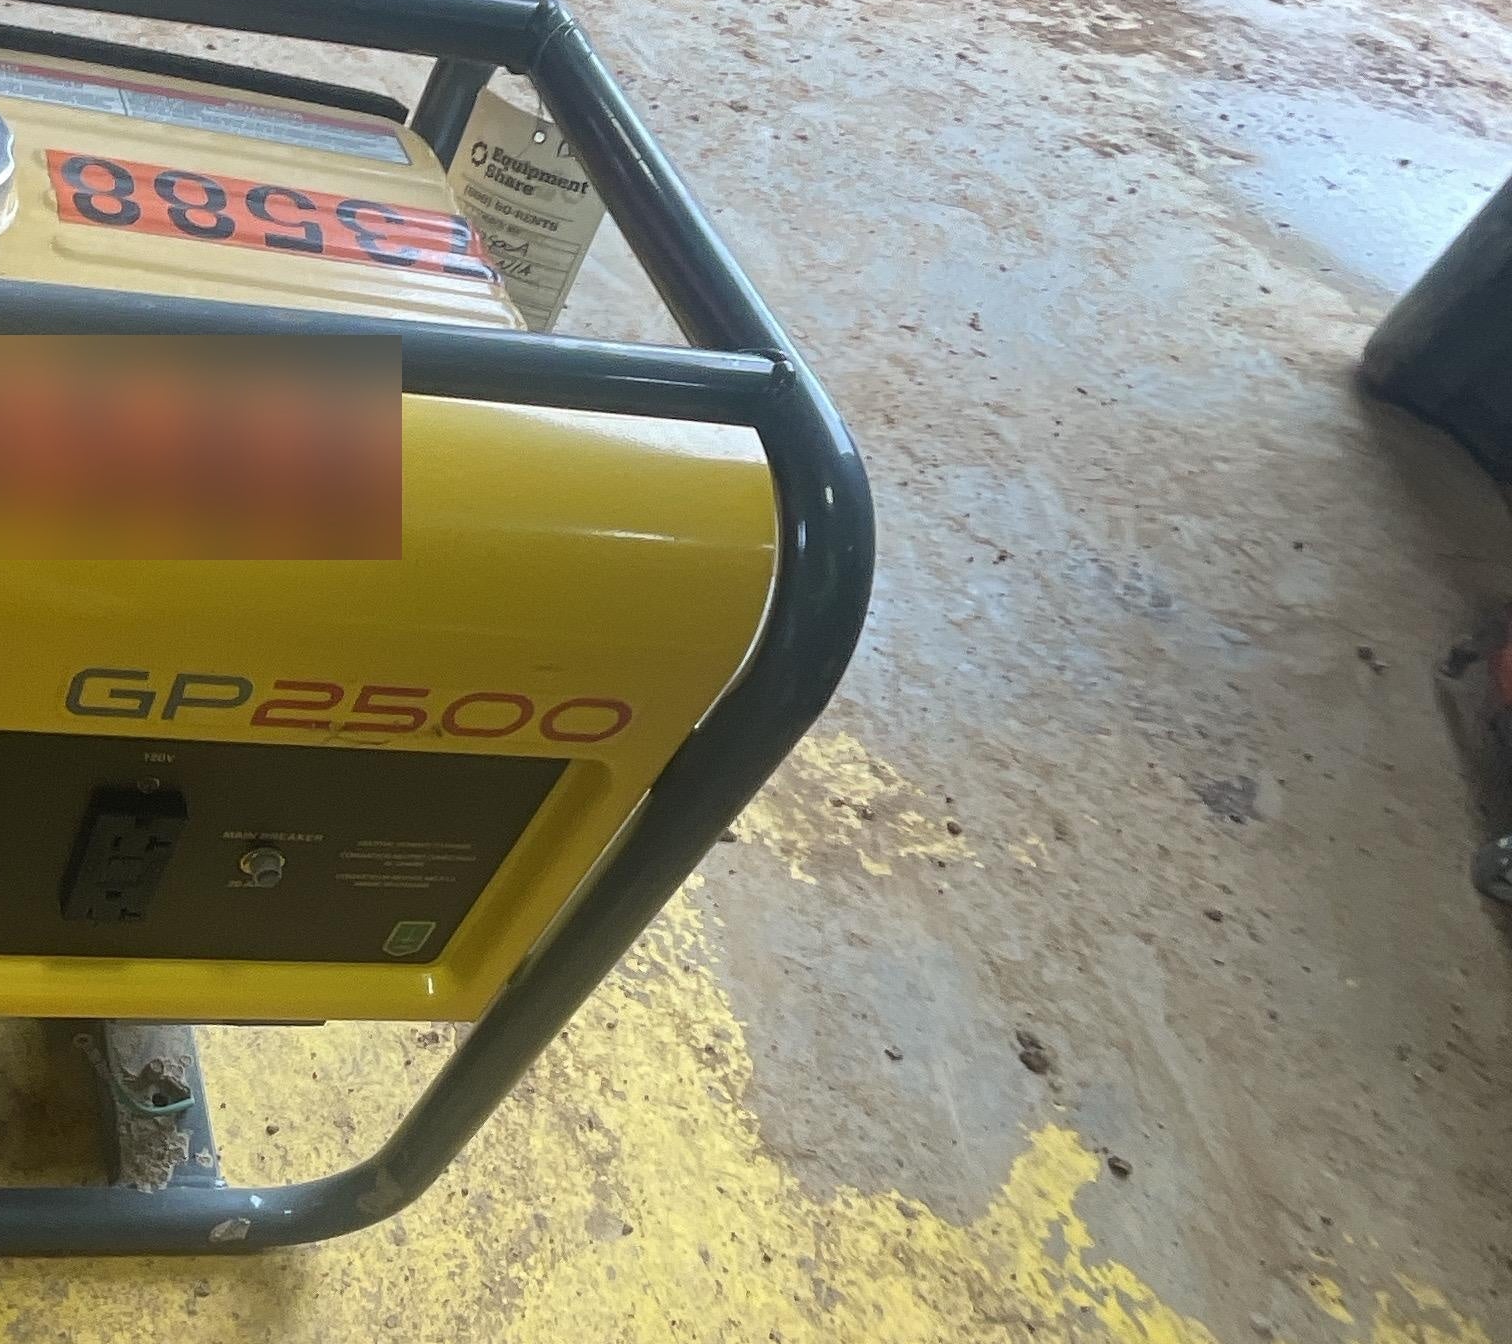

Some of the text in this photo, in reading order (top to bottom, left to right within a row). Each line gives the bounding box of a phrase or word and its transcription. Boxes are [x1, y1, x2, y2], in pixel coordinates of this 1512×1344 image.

[485, 163, 535, 196] Share
[492, 146, 589, 194] Equipment
[65, 667, 634, 744] GP2500
